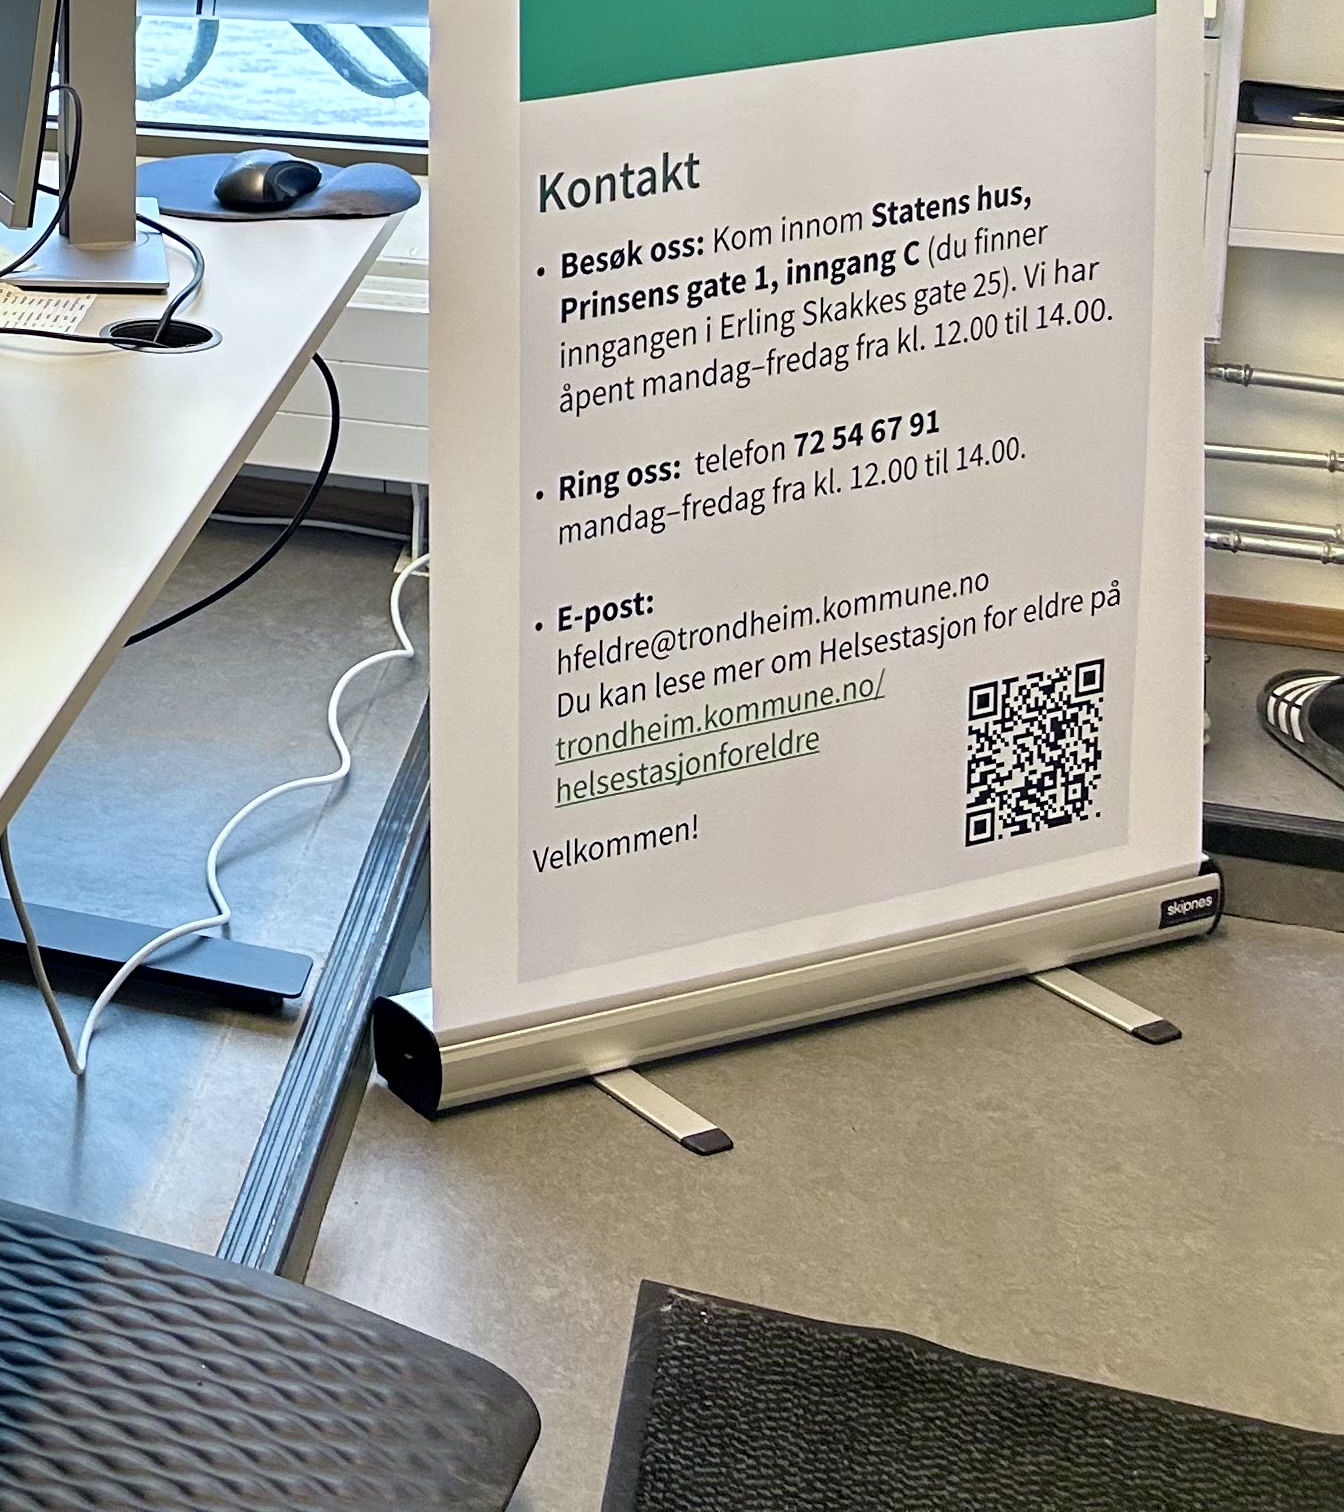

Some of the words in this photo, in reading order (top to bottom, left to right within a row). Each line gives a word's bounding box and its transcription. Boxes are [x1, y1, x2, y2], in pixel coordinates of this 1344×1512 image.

[540, 152, 700, 212] Kontakt
[562, 240, 642, 278] Besøk
[651, 237, 703, 262] oss:
[714, 226, 771, 253] Kom
[782, 212, 862, 242] innom
[872, 195, 969, 227] Statens
[978, 185, 1031, 211] hus,
[562, 285, 679, 323] Prinsens
[687, 272, 746, 308] gate
[755, 266, 778, 294] 1,
[787, 250, 896, 285] inngang
[904, 241, 919, 265] C
[929, 233, 966, 268] (du
[975, 225, 1048, 254] finner
[560, 377, 634, 417] åpent
[644, 342, 849, 397] mandag–fredag
[856, 333, 888, 360] fra
[898, 325, 925, 354] kl.
[935, 314, 997, 347] 12.00
[1005, 306, 1027, 334] til
[1036, 298, 1112, 329] 14.00.
[561, 326, 696, 368] inngangen
[707, 316, 711, 342] i
[722, 309, 795, 340] Erling
[803, 290, 906, 326] Skakkes
[914, 280, 966, 315] gate
[974, 267, 1016, 298] 25).
[1024, 261, 1045, 288] Vi
[1055, 259, 1099, 284] har
[560, 471, 619, 501] Ring
[627, 461, 680, 486] oss:
[695, 439, 784, 475] telefon
[794, 430, 824, 457] 72
[832, 423, 863, 450] 54
[871, 416, 902, 443] 67
[910, 410, 939, 436] 91
[560, 486, 765, 545] mandag–fredag
[773, 477, 804, 504] fra
[815, 468, 841, 497] kl.
[851, 456, 917, 490] 12.00
[925, 448, 948, 476] til
[957, 437, 1025, 470] 14.00.
[558, 573, 988, 675] hfeldre@trondheim.kommune.no
[559, 593, 653, 632] E-post:
[559, 693, 589, 717] Du
[601, 683, 645, 709] kan
[657, 671, 705, 698] lese
[714, 658, 764, 686] mer
[772, 650, 810, 673] om
[821, 617, 975, 664] Helsestasjon
[984, 605, 1017, 631] for
[1024, 592, 1083, 622] eldre
[1091, 580, 1120, 616] på
[555, 668, 885, 766] trondheim.kommune.no/
[555, 729, 820, 808] helsestasjonforeldre
[533, 814, 697, 872] Velkommen!
[1167, 895, 1212, 916] skipnes
